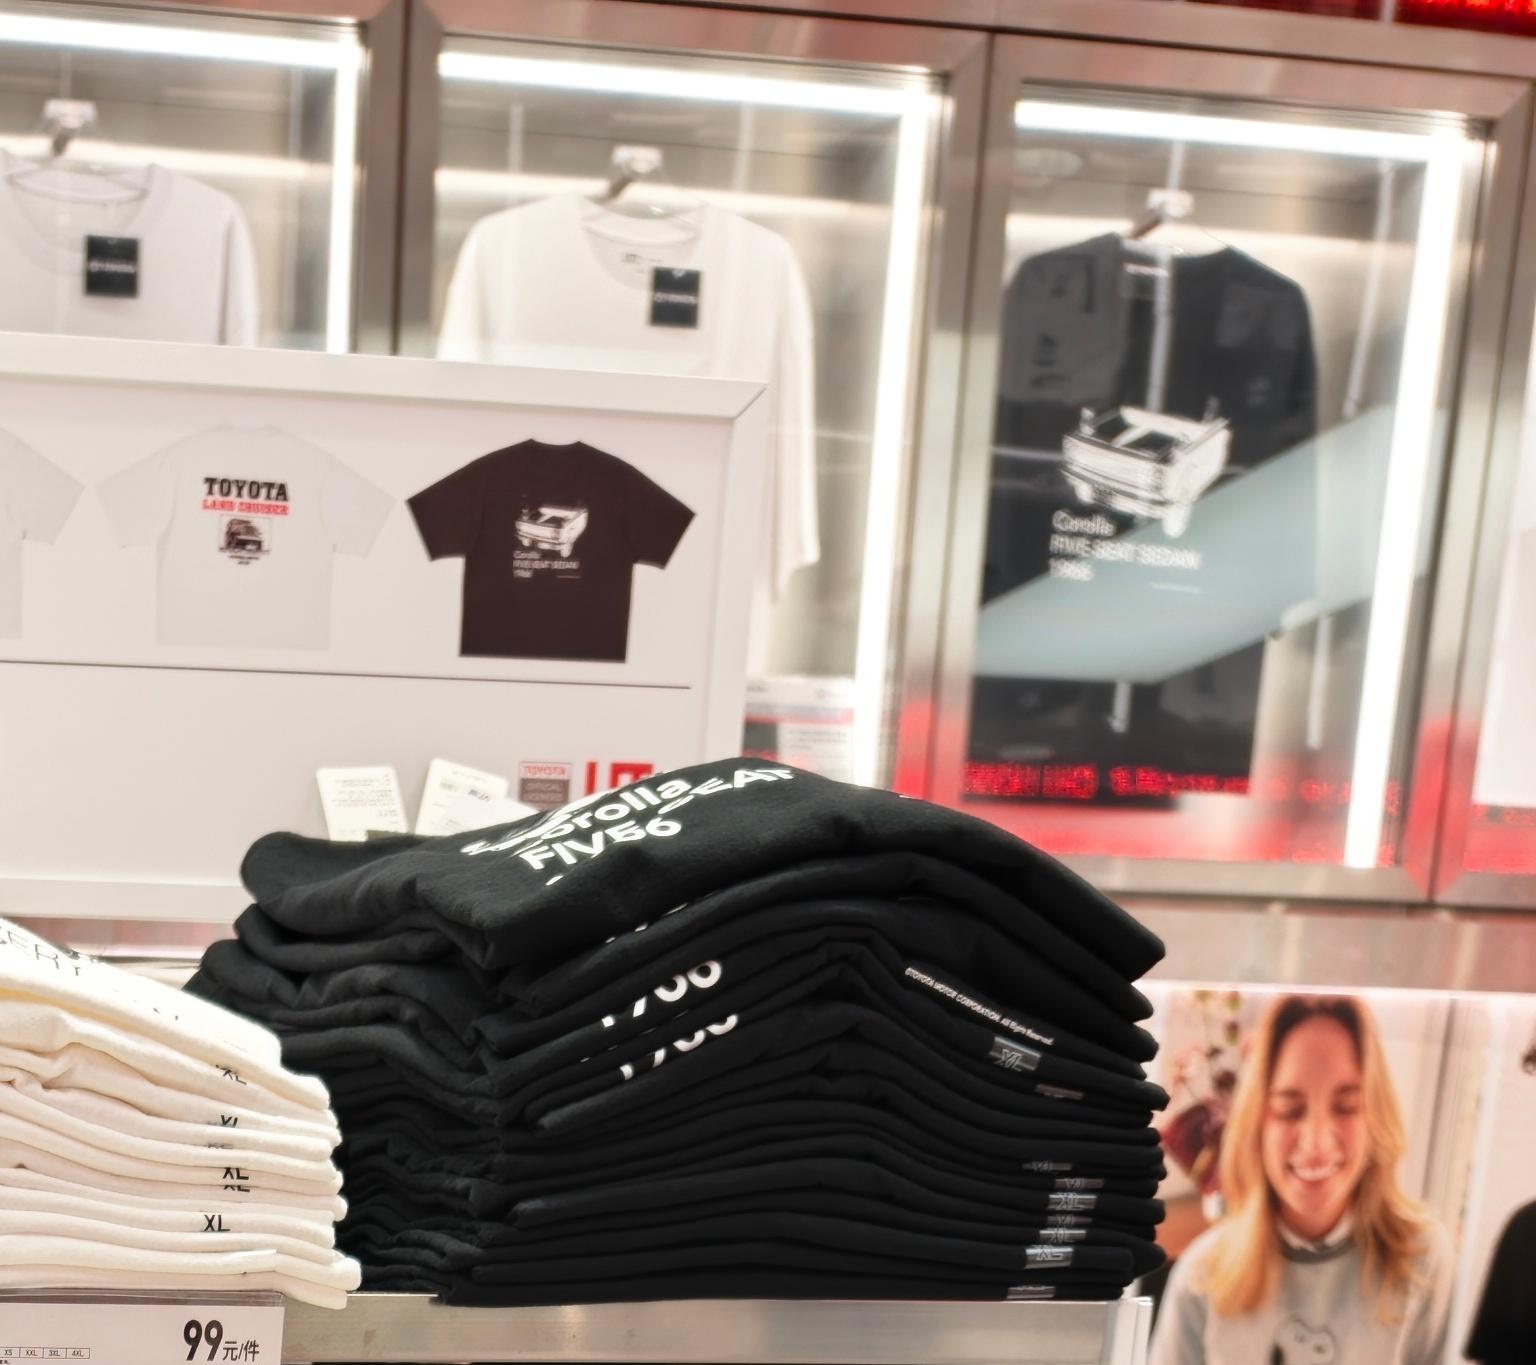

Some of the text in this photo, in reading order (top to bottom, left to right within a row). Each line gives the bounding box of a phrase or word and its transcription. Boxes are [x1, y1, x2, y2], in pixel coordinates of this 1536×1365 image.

[203, 477, 289, 502] TOYOTA
[203, 1214, 231, 1233] XL
[183, 1319, 260, 1363] 99元/件
